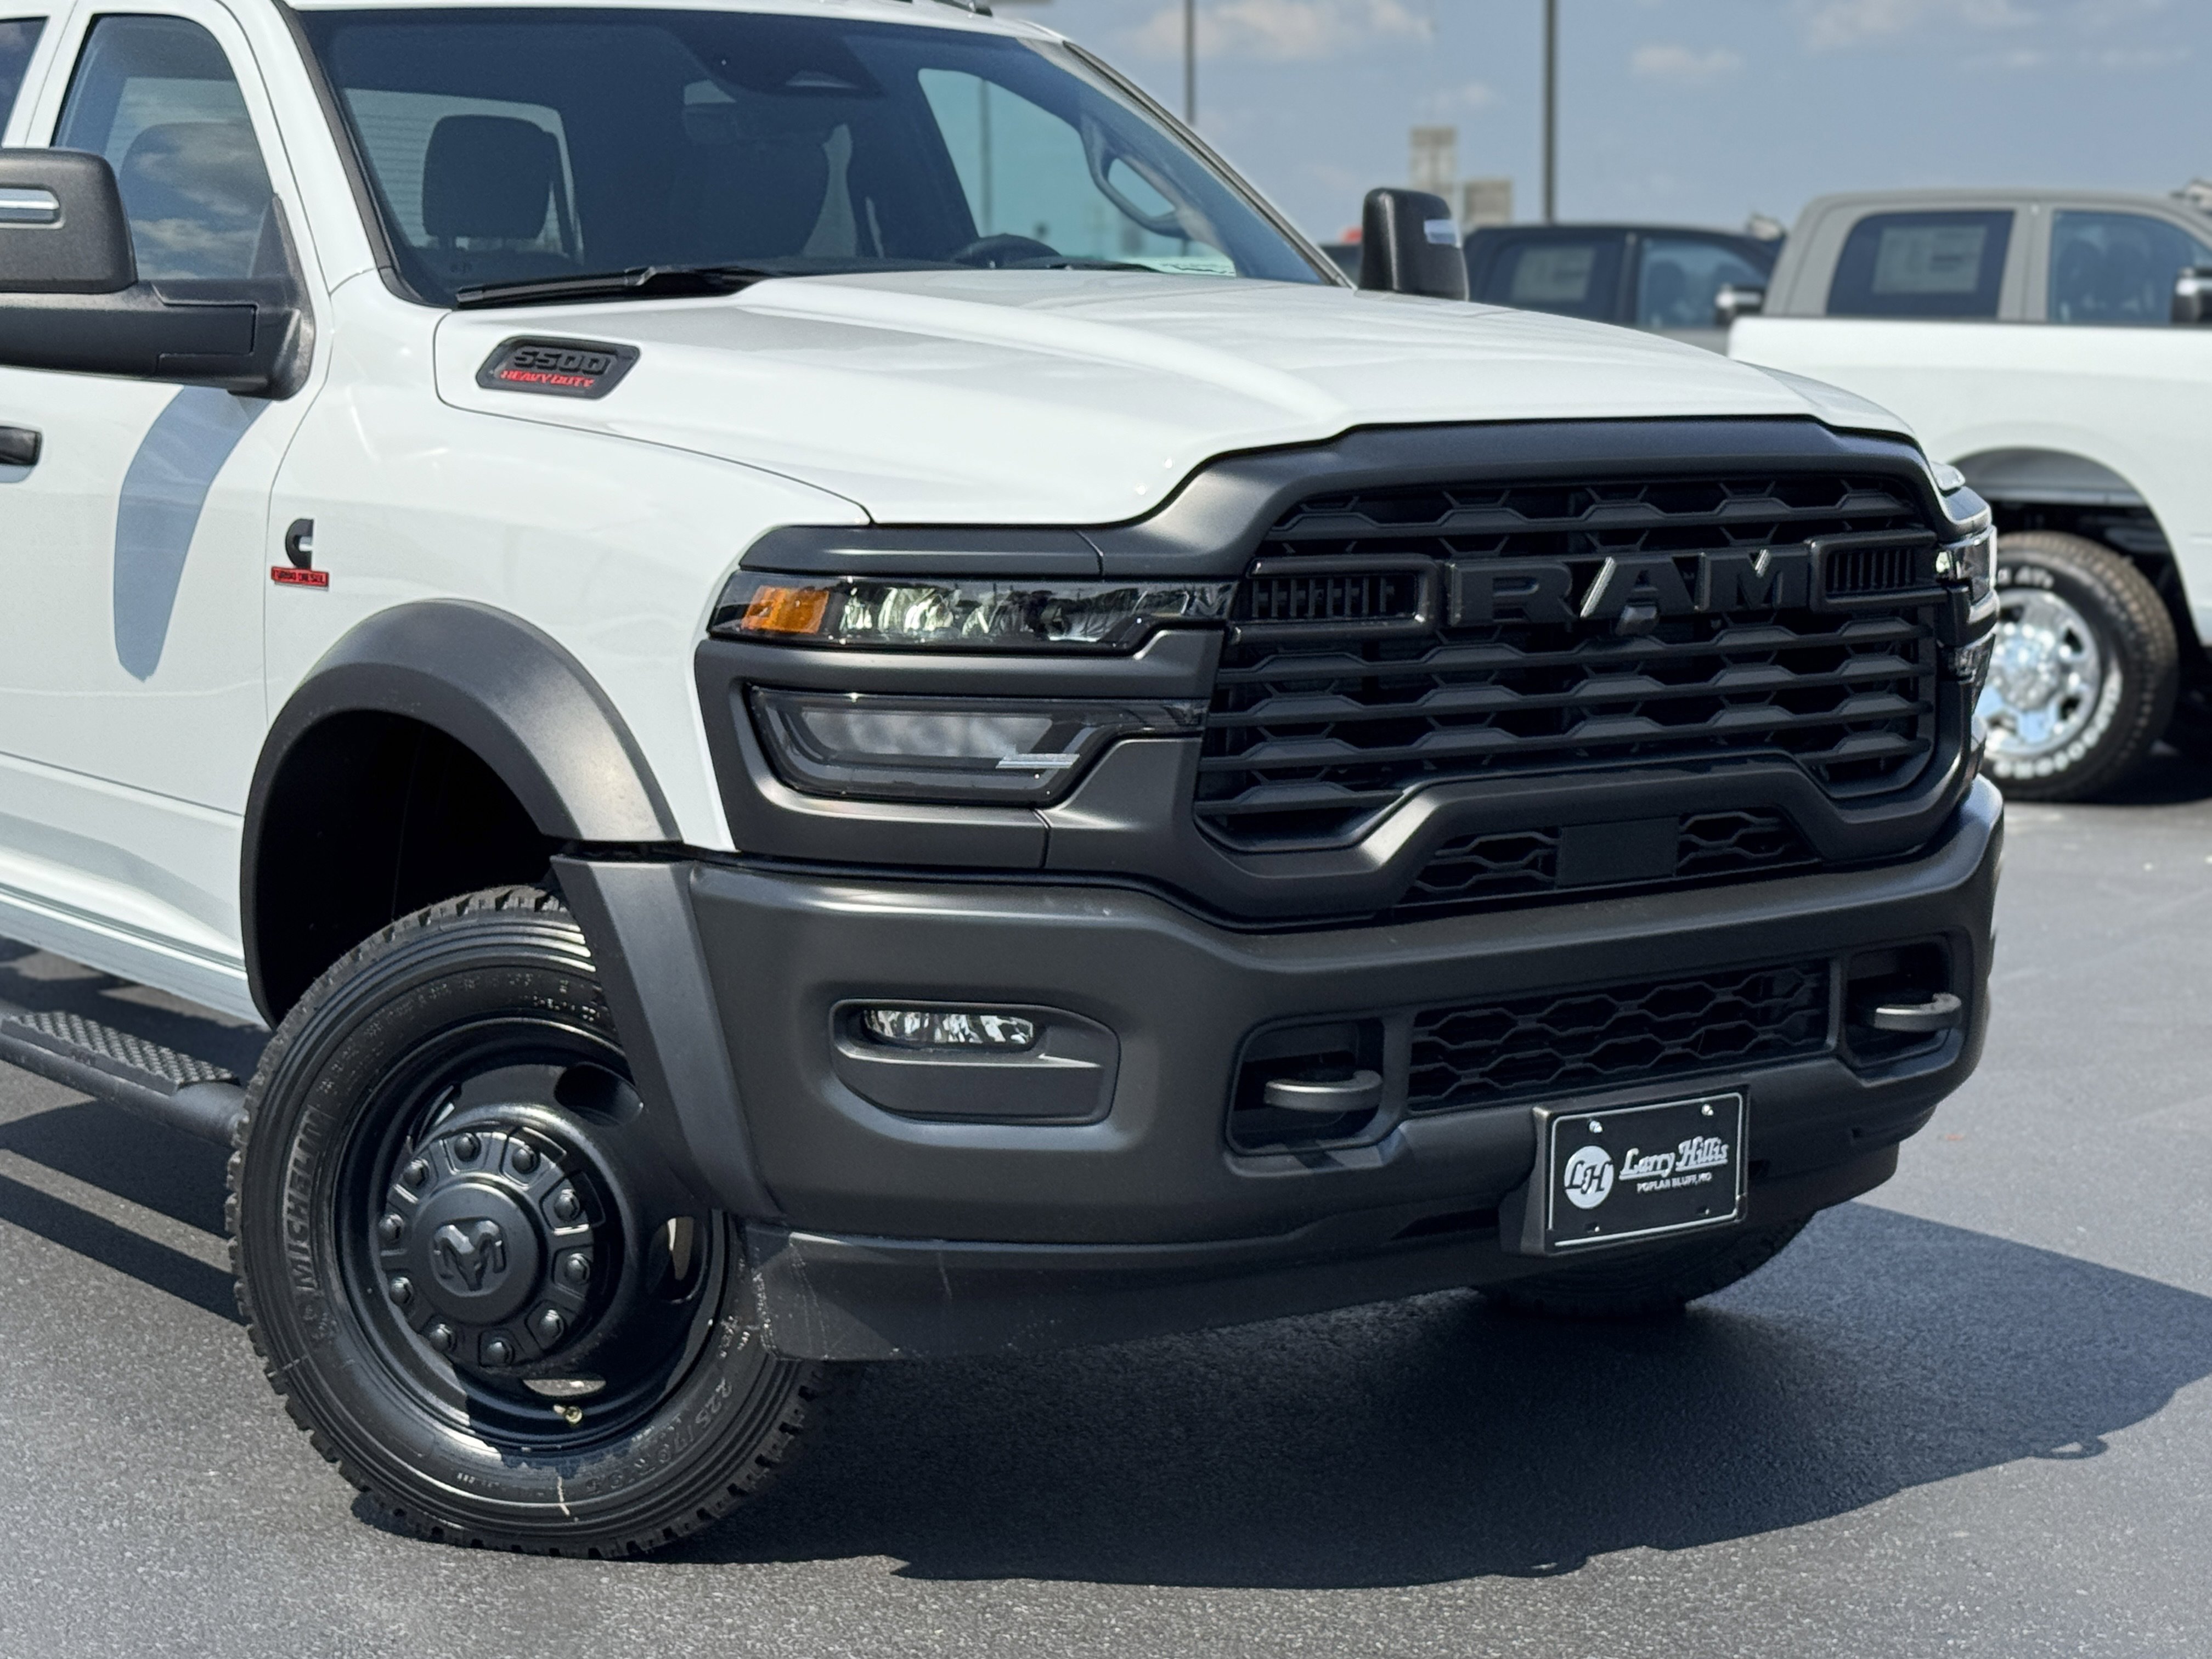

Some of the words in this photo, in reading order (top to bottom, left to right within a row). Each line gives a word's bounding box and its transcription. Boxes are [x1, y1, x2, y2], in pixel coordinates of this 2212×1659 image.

[500, 370, 551, 383] HEAVY
[550, 374, 595, 387] DUTY
[511, 348, 608, 375] 5500
[1448, 550, 1809, 627] RAM
[1618, 1148, 1675, 1178] Larry
[1675, 1135, 1729, 1172] Hillis
[284, 1109, 319, 1290] MICHELIN
[1637, 1180, 1671, 1193] POPLAR
